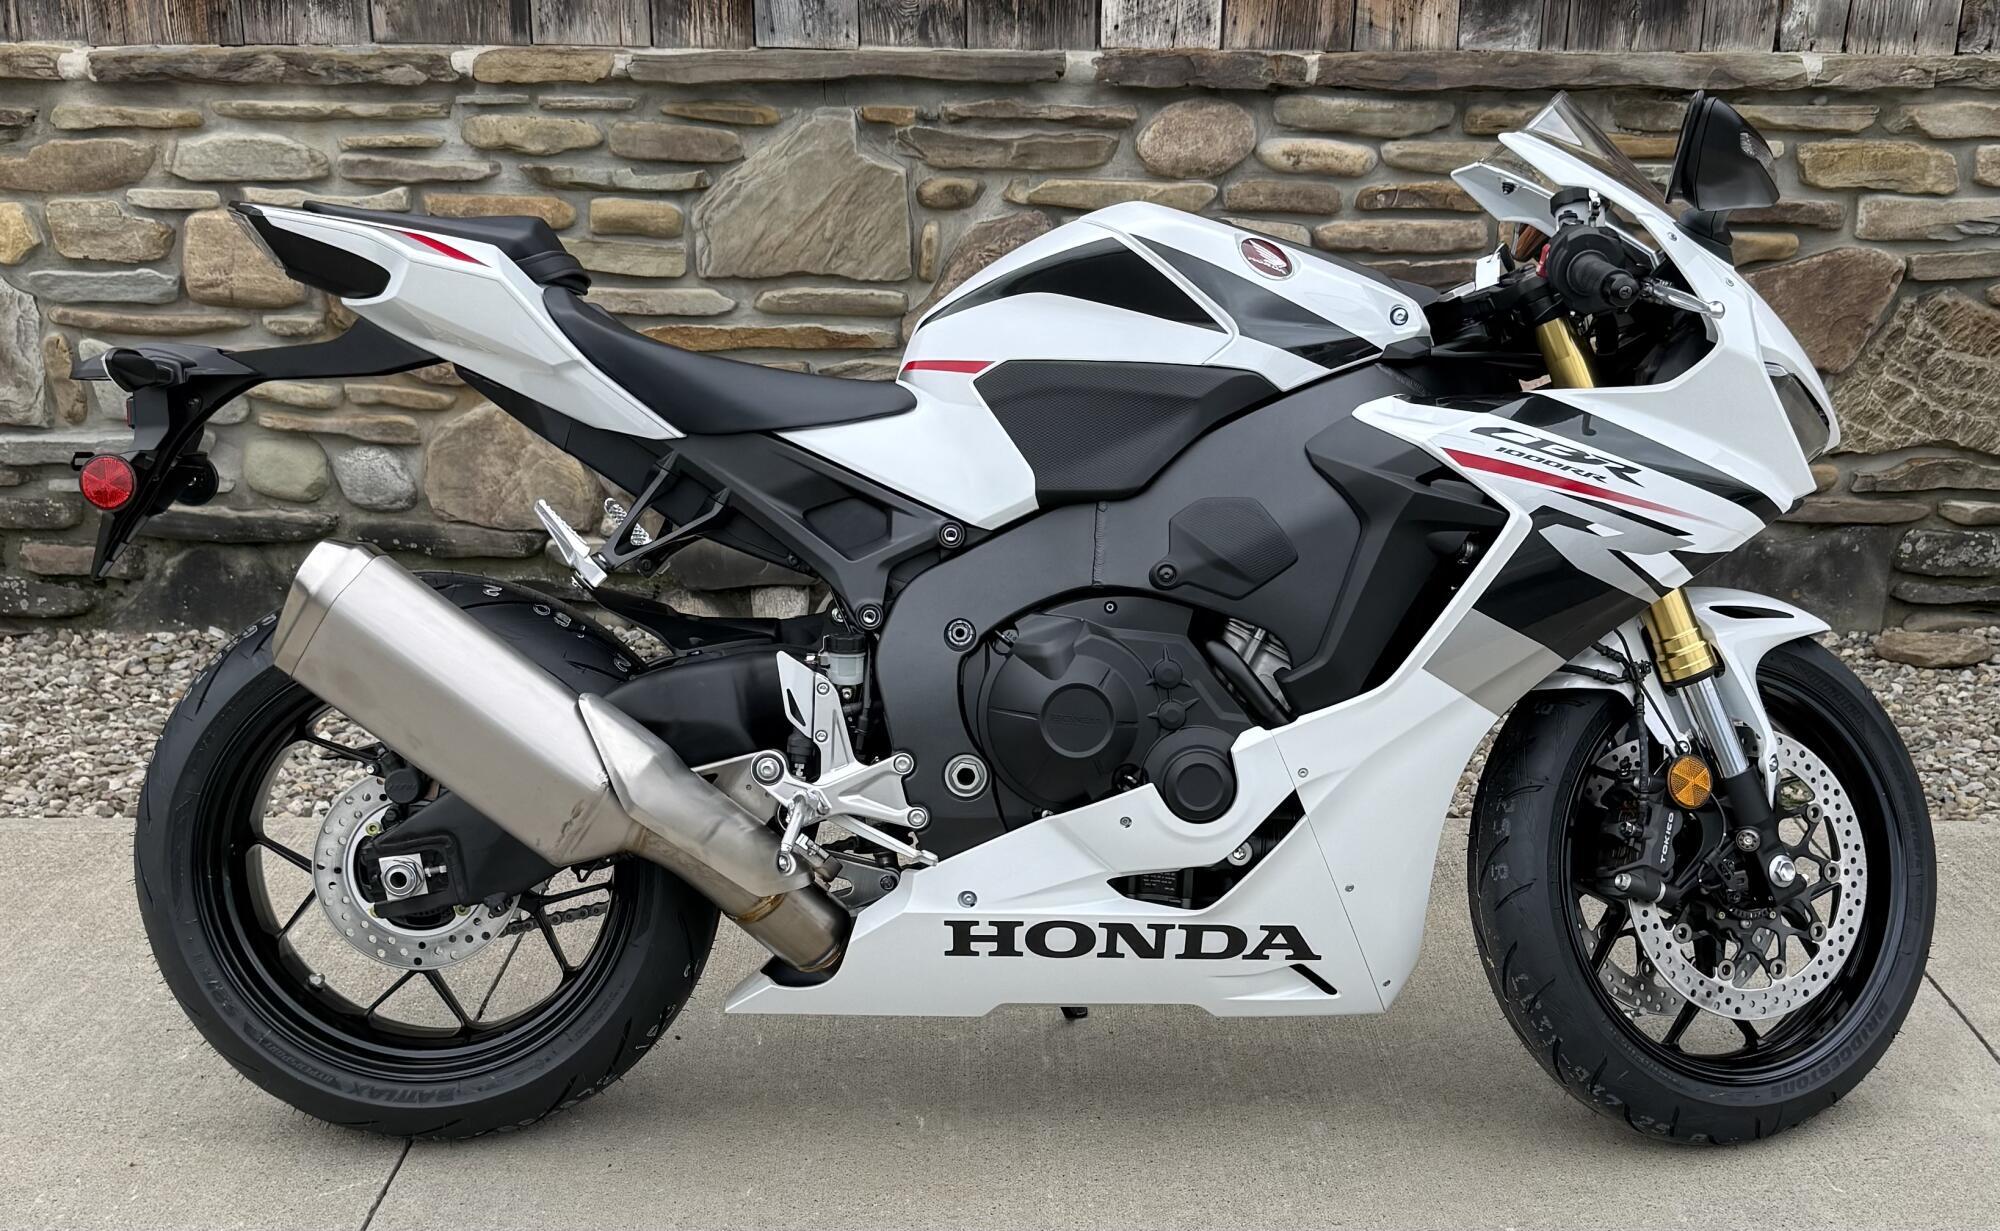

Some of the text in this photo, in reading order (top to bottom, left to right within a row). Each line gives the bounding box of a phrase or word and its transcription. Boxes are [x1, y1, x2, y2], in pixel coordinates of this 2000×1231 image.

[1470, 427, 1645, 488] CBR
[1495, 447, 1607, 484] 1000RR
[1660, 812, 1674, 864] TOKICO
[944, 920, 1321, 960] HONDA
[1770, 1000, 1889, 1097] BRIDGESTONE
